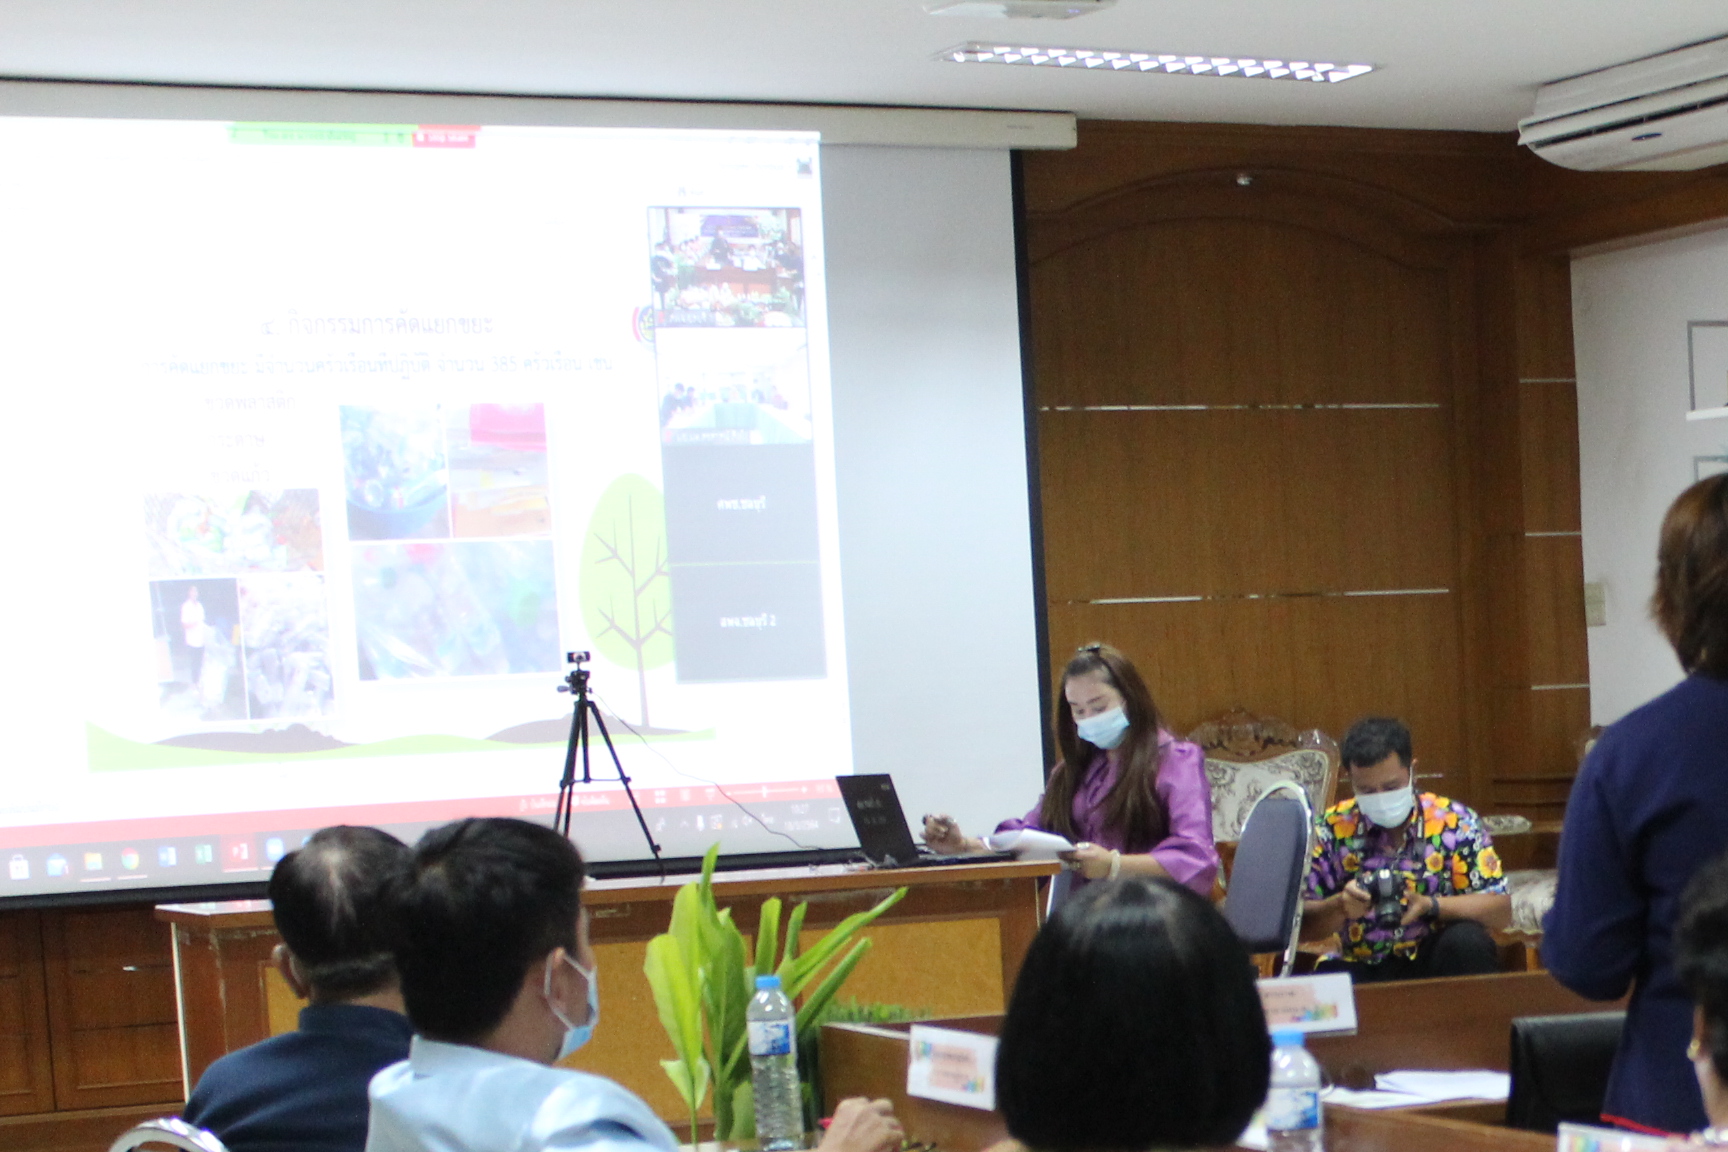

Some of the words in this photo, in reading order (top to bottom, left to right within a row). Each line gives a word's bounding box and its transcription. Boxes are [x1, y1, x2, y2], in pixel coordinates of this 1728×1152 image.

[287, 308, 493, 336] กิจกรรมการคัดแยกขยะ
[490, 355, 517, 373] 385
[204, 388, 296, 411] ขวดพลาสติก
[769, 613, 777, 627] 2
